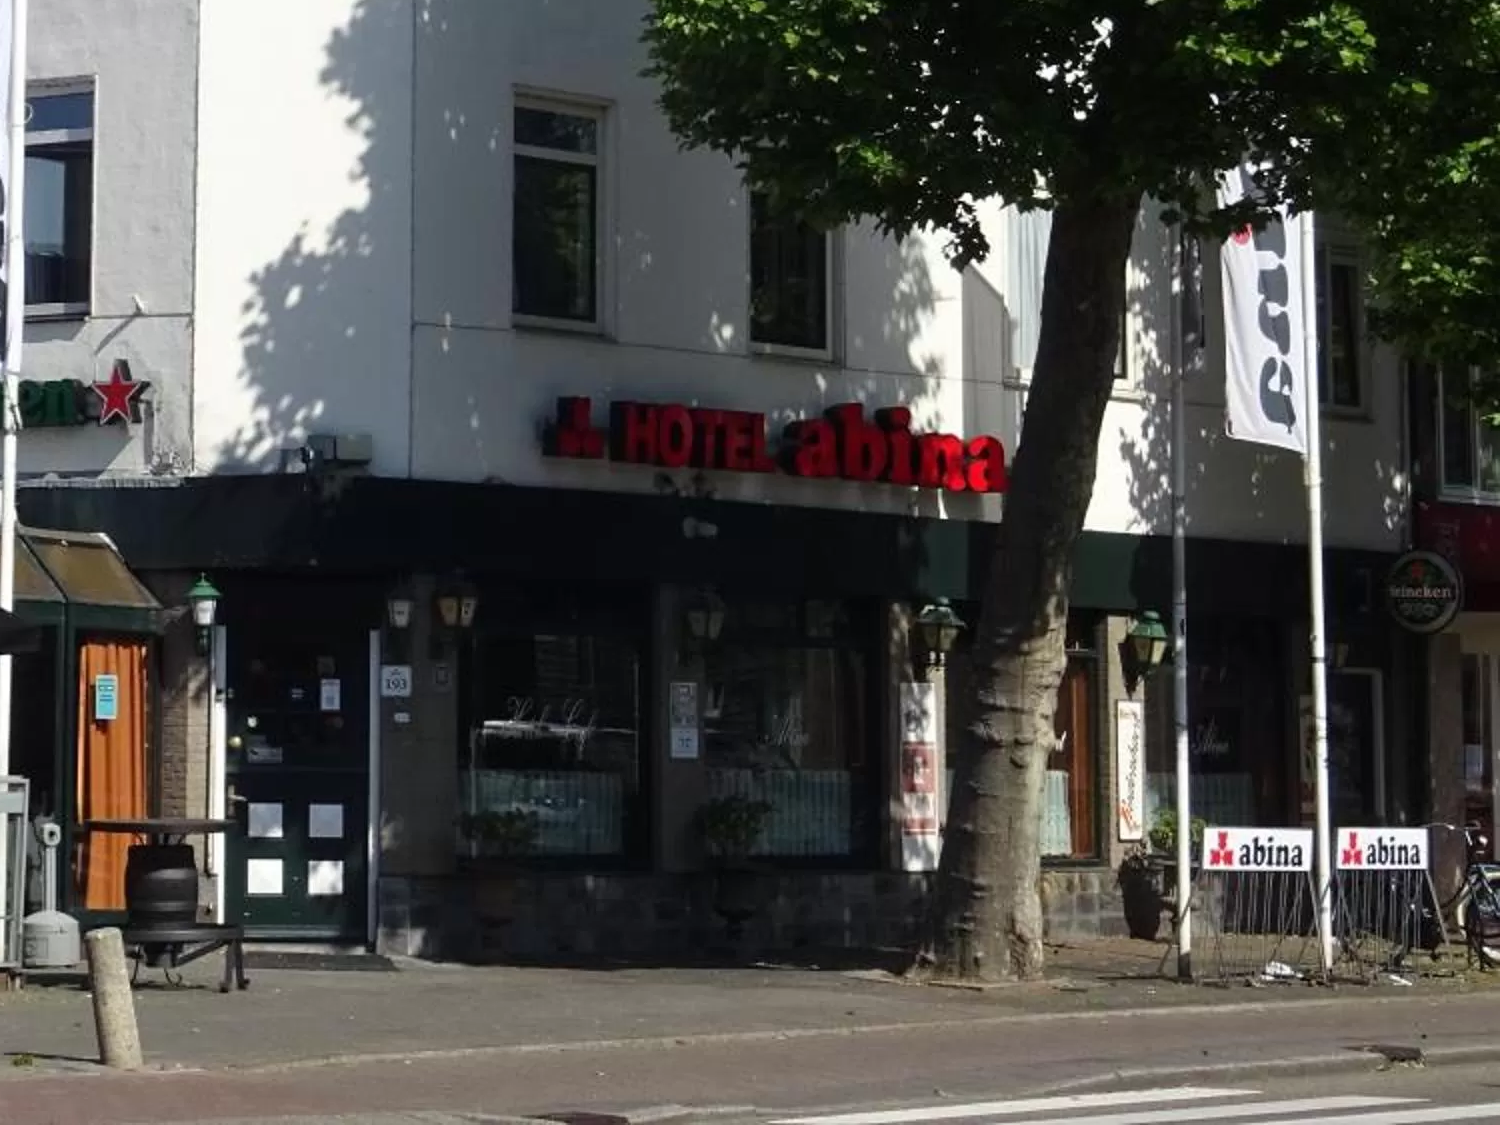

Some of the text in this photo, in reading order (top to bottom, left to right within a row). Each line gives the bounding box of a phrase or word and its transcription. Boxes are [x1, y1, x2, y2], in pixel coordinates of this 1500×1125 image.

[611, 401, 1008, 493] HOTEL abina
[1239, 836, 1303, 867] abina
[1366, 836, 1421, 866] abina
